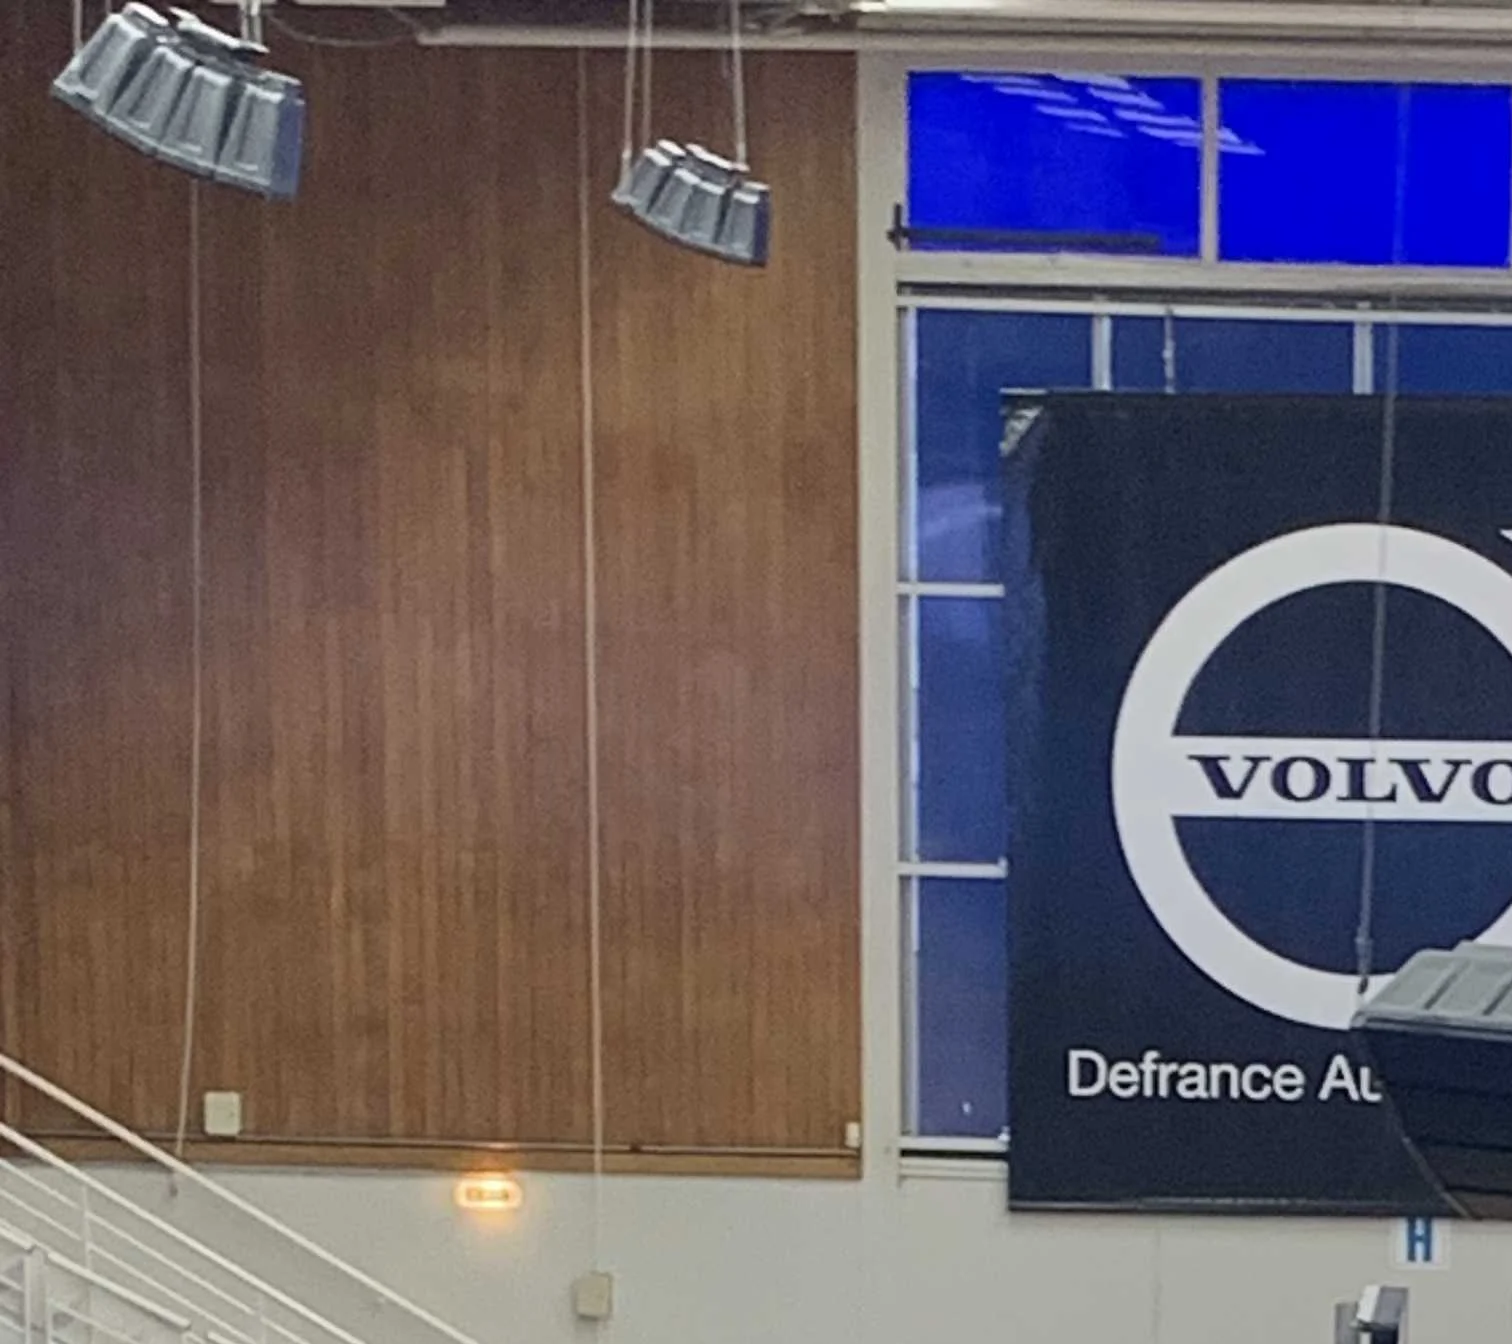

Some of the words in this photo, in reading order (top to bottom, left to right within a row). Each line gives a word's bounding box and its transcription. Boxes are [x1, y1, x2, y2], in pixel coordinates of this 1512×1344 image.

[1067, 1048, 1304, 1102] Defrance
[1318, 1053, 1383, 1103] Au
[1407, 1217, 1433, 1262] H
